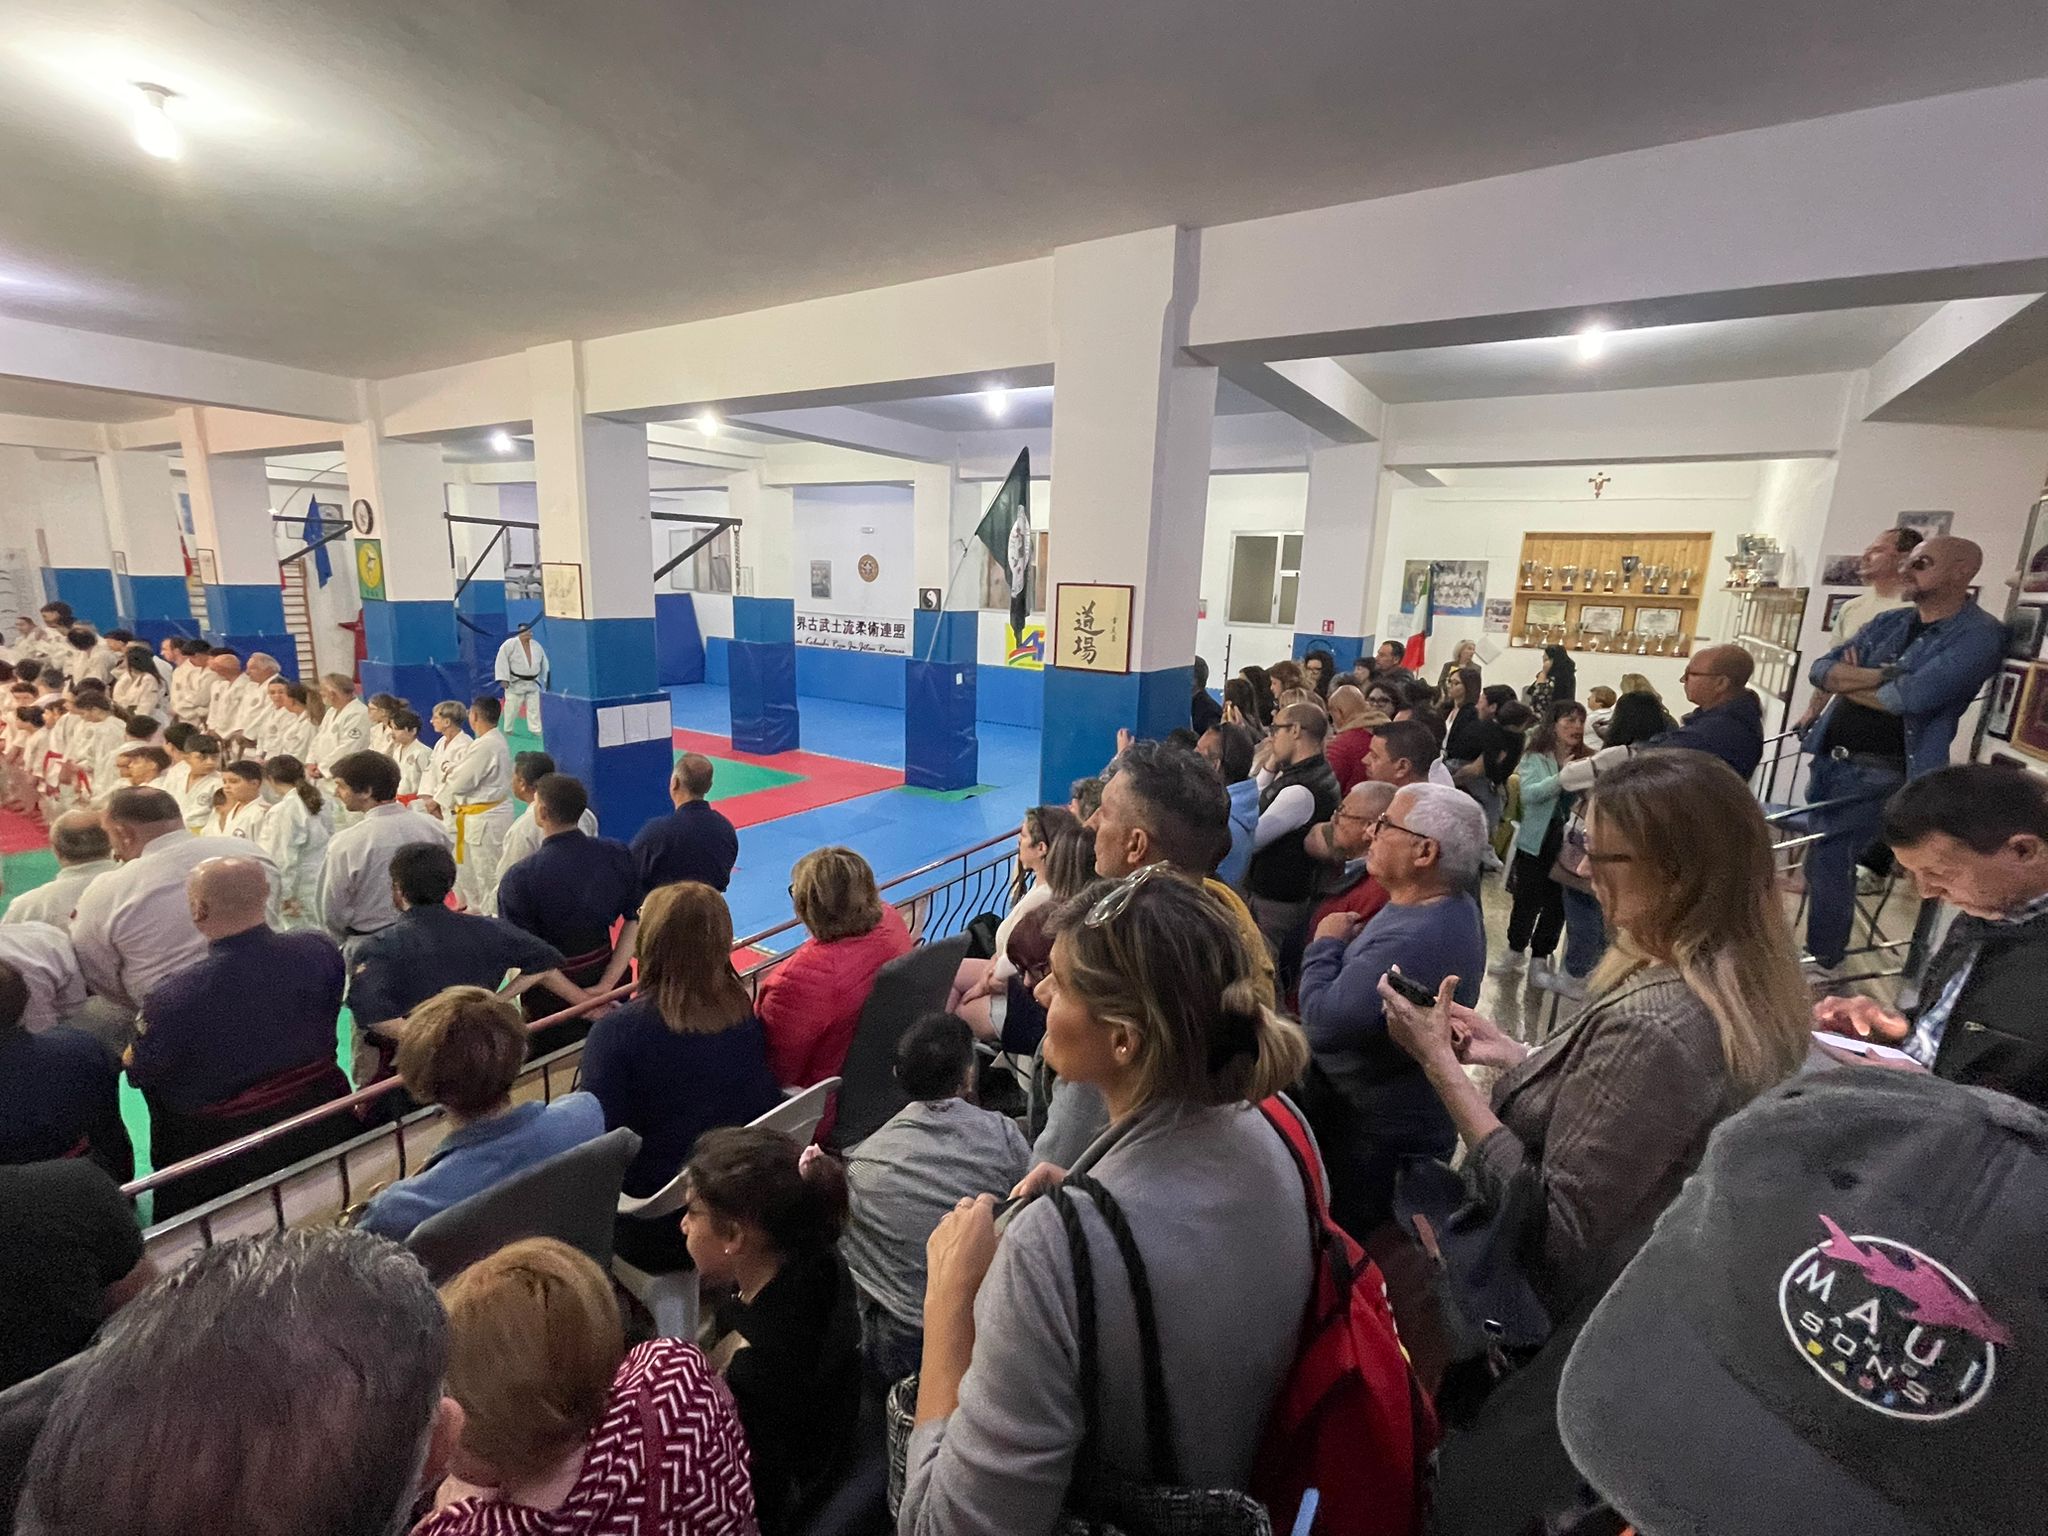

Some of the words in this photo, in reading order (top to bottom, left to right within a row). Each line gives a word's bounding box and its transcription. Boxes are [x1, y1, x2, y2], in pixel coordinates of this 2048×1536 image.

[1072, 599, 1106, 665] 道場
[1794, 1260, 1980, 1393] MAUI
[1799, 1311, 1930, 1405] SONS
